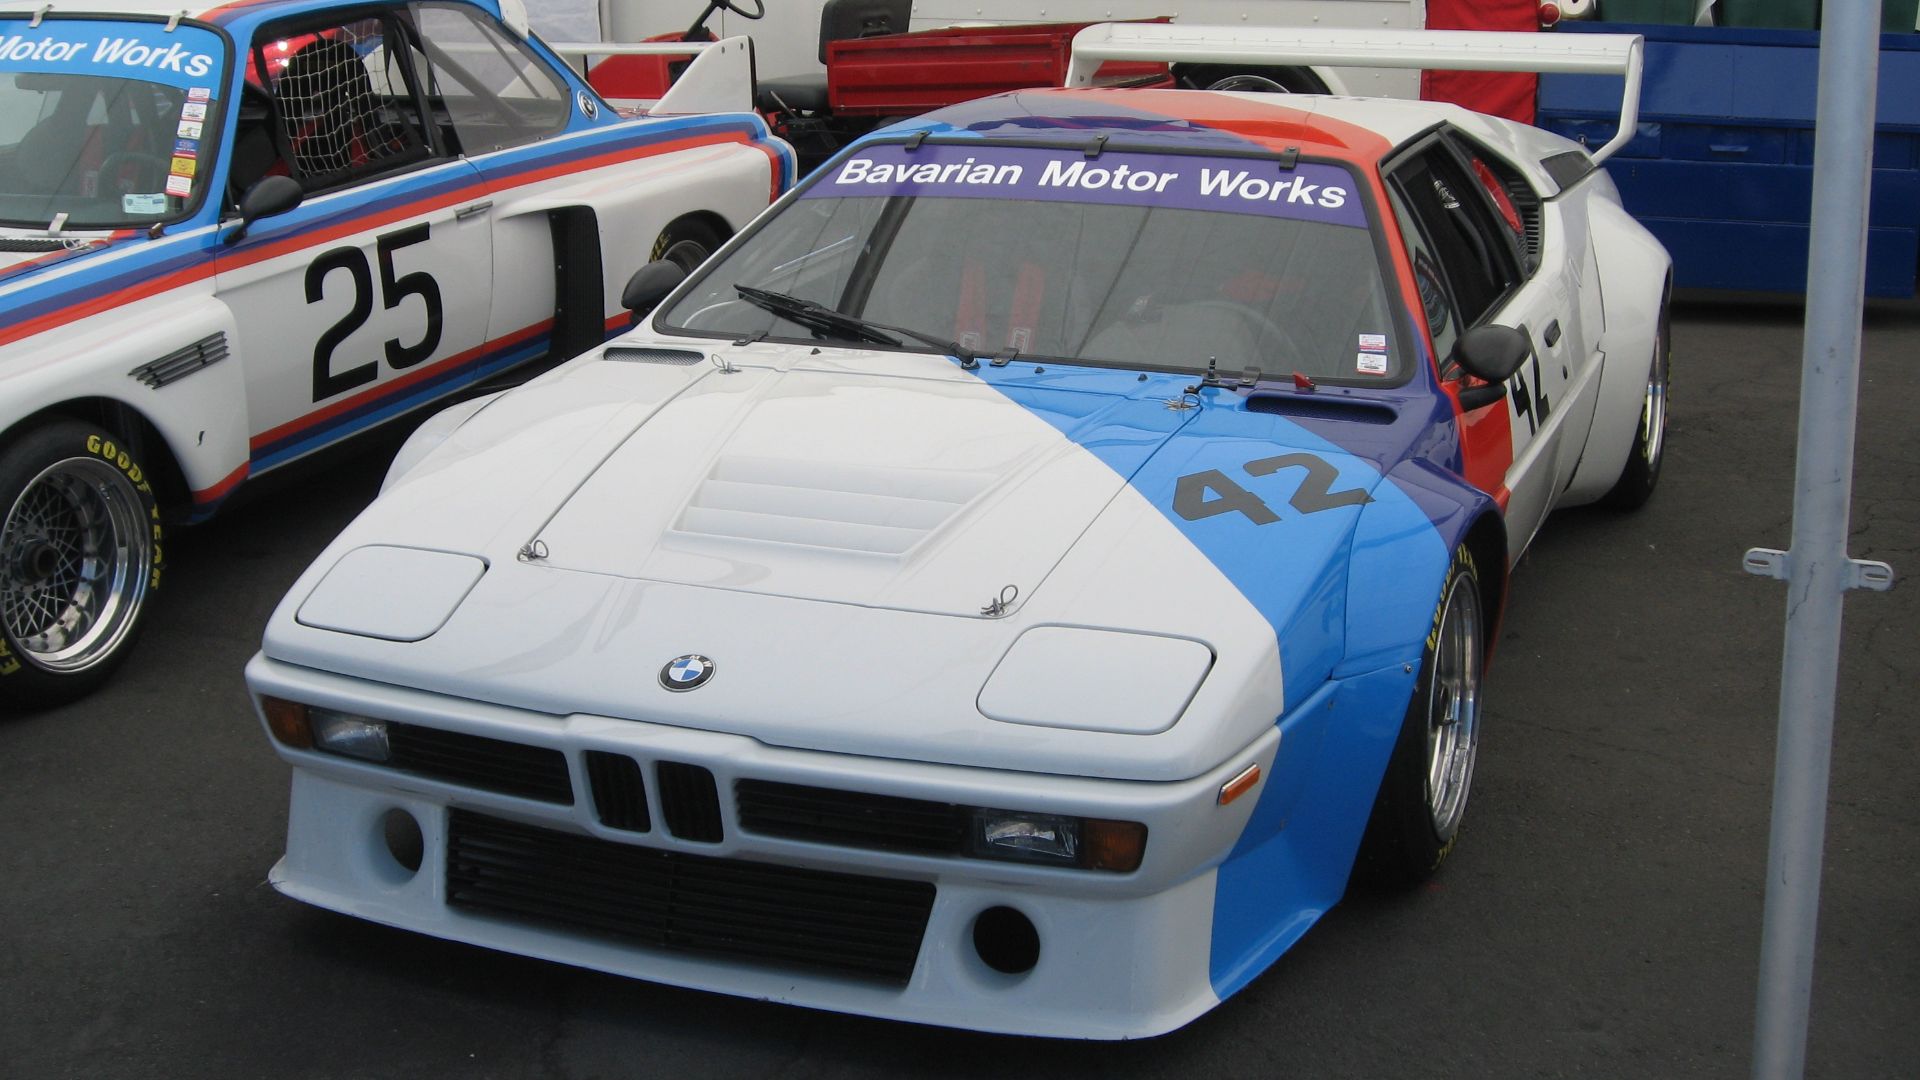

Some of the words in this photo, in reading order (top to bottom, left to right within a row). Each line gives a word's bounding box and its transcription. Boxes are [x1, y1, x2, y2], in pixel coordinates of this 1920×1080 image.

[92, 37, 213, 77] Works
[835, 157, 1023, 186] Bavarian
[1037, 160, 1178, 193] Motor
[1199, 168, 1347, 209] Works
[304, 221, 443, 403] 25
[1172, 452, 1376, 526] 42
